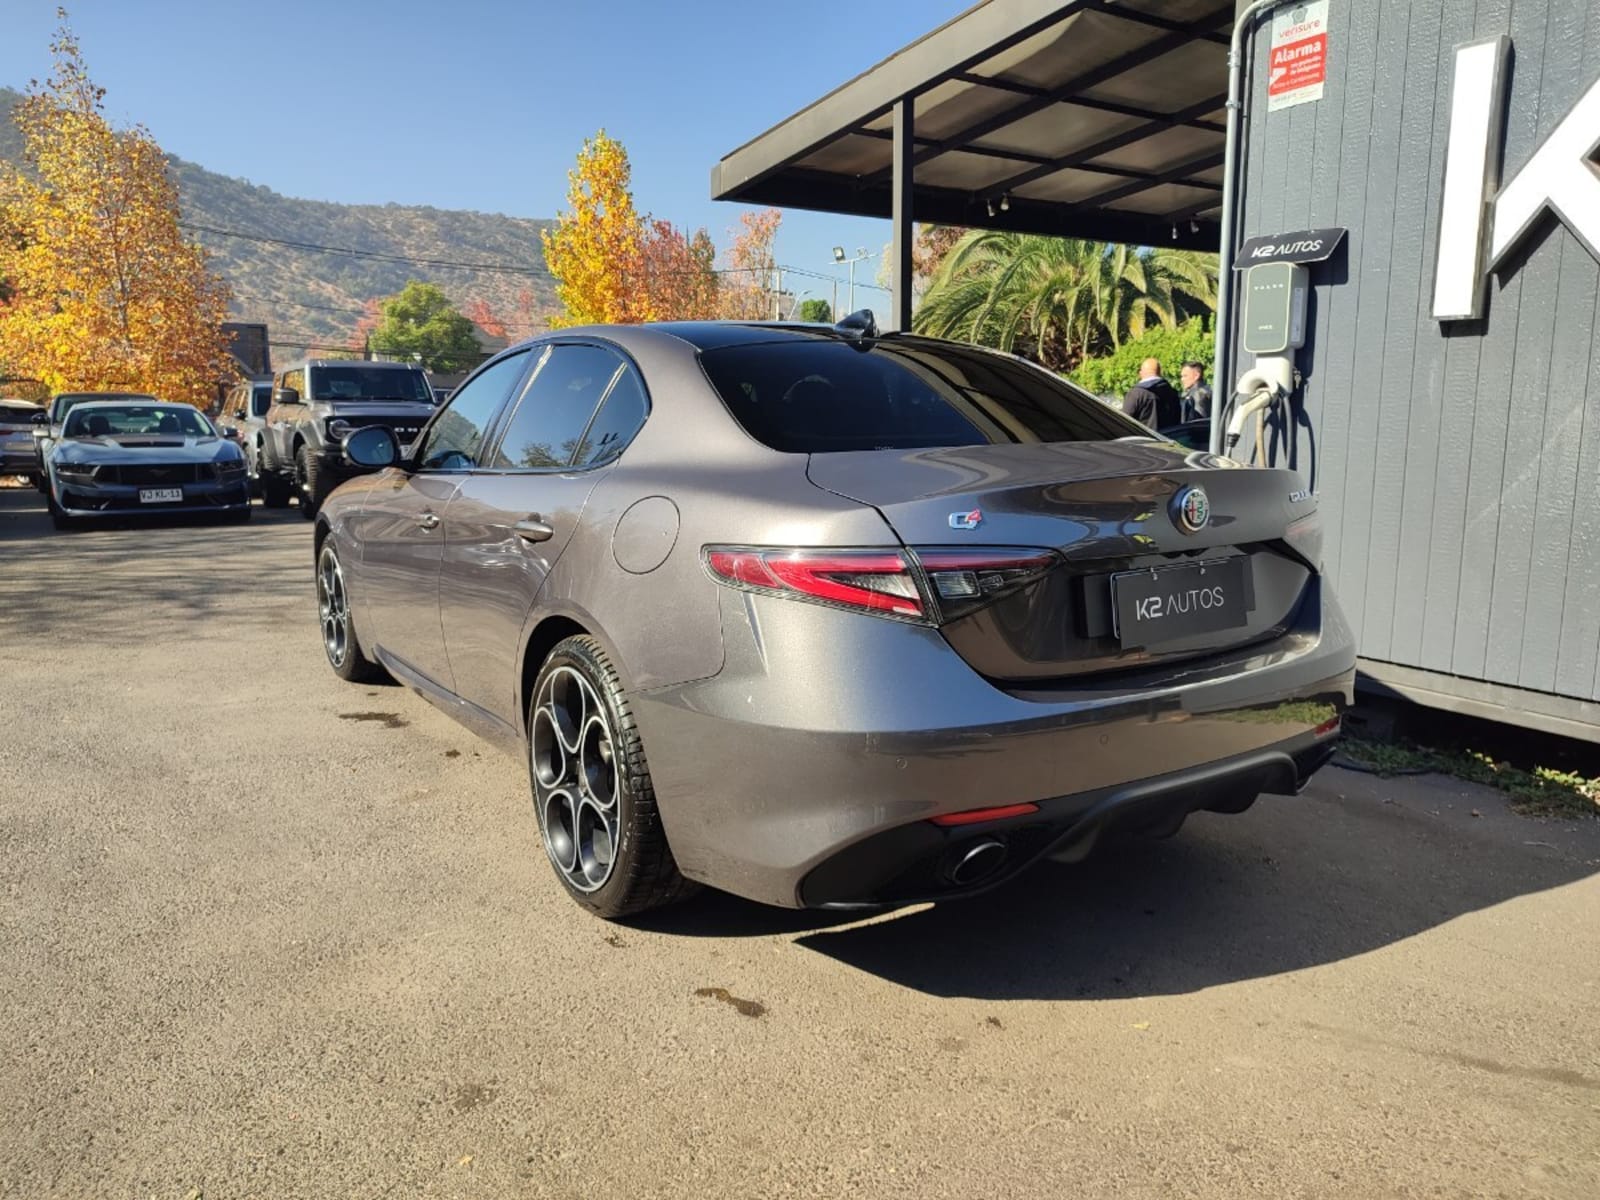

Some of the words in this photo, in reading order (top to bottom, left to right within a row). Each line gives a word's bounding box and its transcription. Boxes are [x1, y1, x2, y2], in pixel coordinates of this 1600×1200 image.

[1273, 41, 1322, 65] Alarma
[1251, 245, 1275, 258] K2
[1273, 240, 1323, 256] AUTOS
[1135, 596, 1163, 621] K2
[1165, 586, 1225, 616] AUTOS
